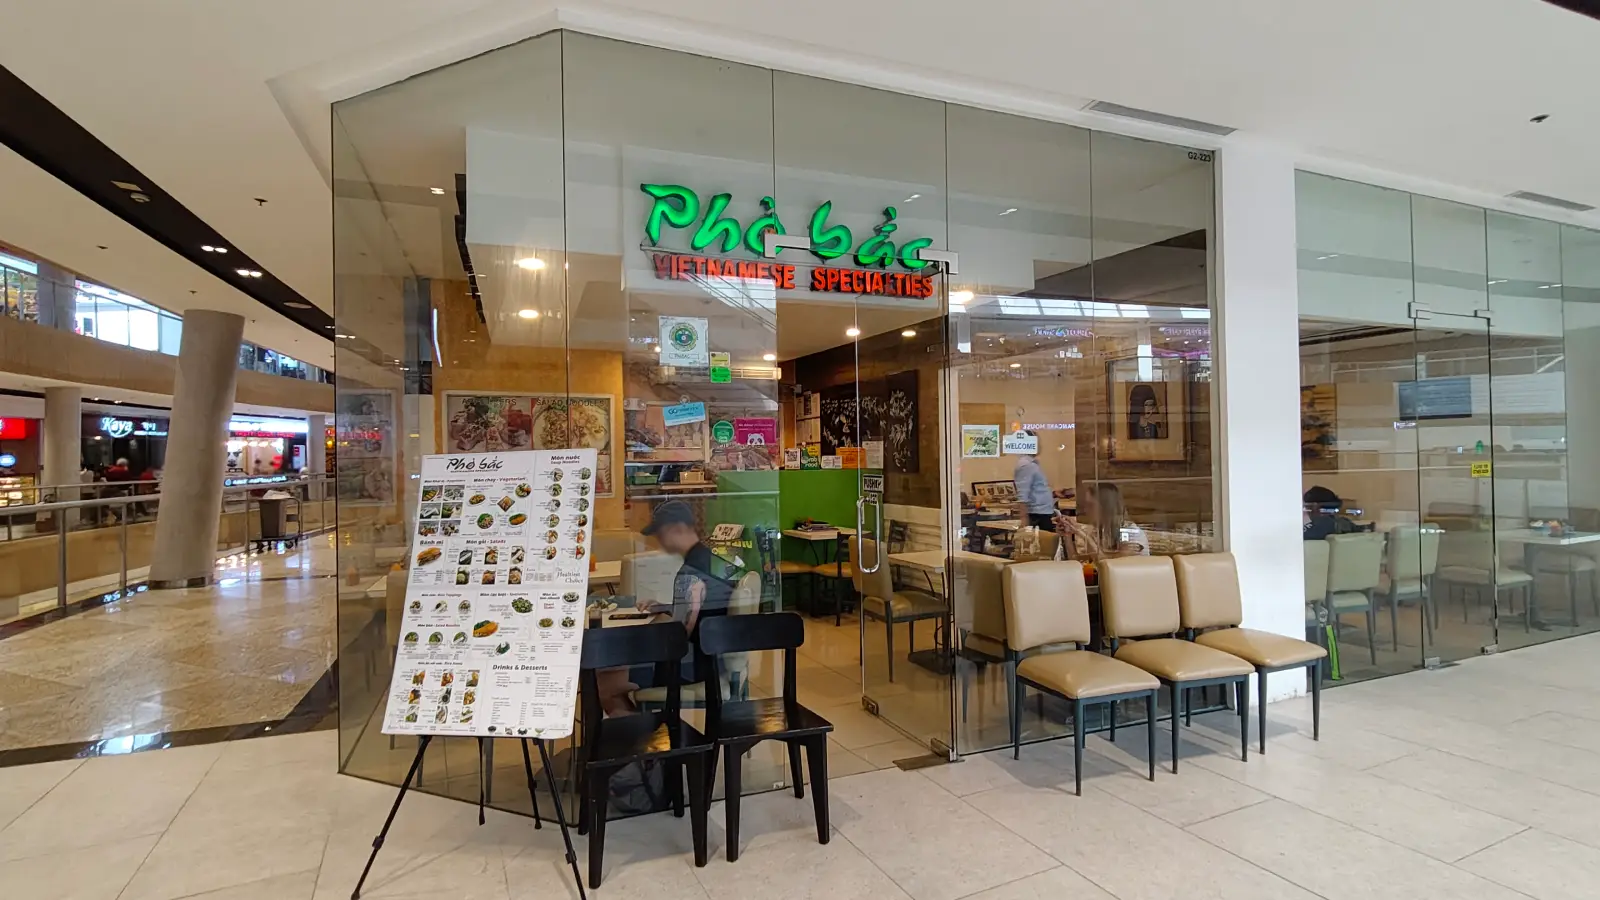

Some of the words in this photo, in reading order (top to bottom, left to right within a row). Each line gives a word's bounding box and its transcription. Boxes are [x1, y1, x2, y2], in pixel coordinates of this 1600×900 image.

[1188, 151, 1211, 163] G2-223
[653, 253, 796, 290] VIETNAMESE
[811, 267, 933, 298] SPECIALTIES
[100, 417, 133, 436] Kaya
[1004, 442, 1036, 450] WELCOME
